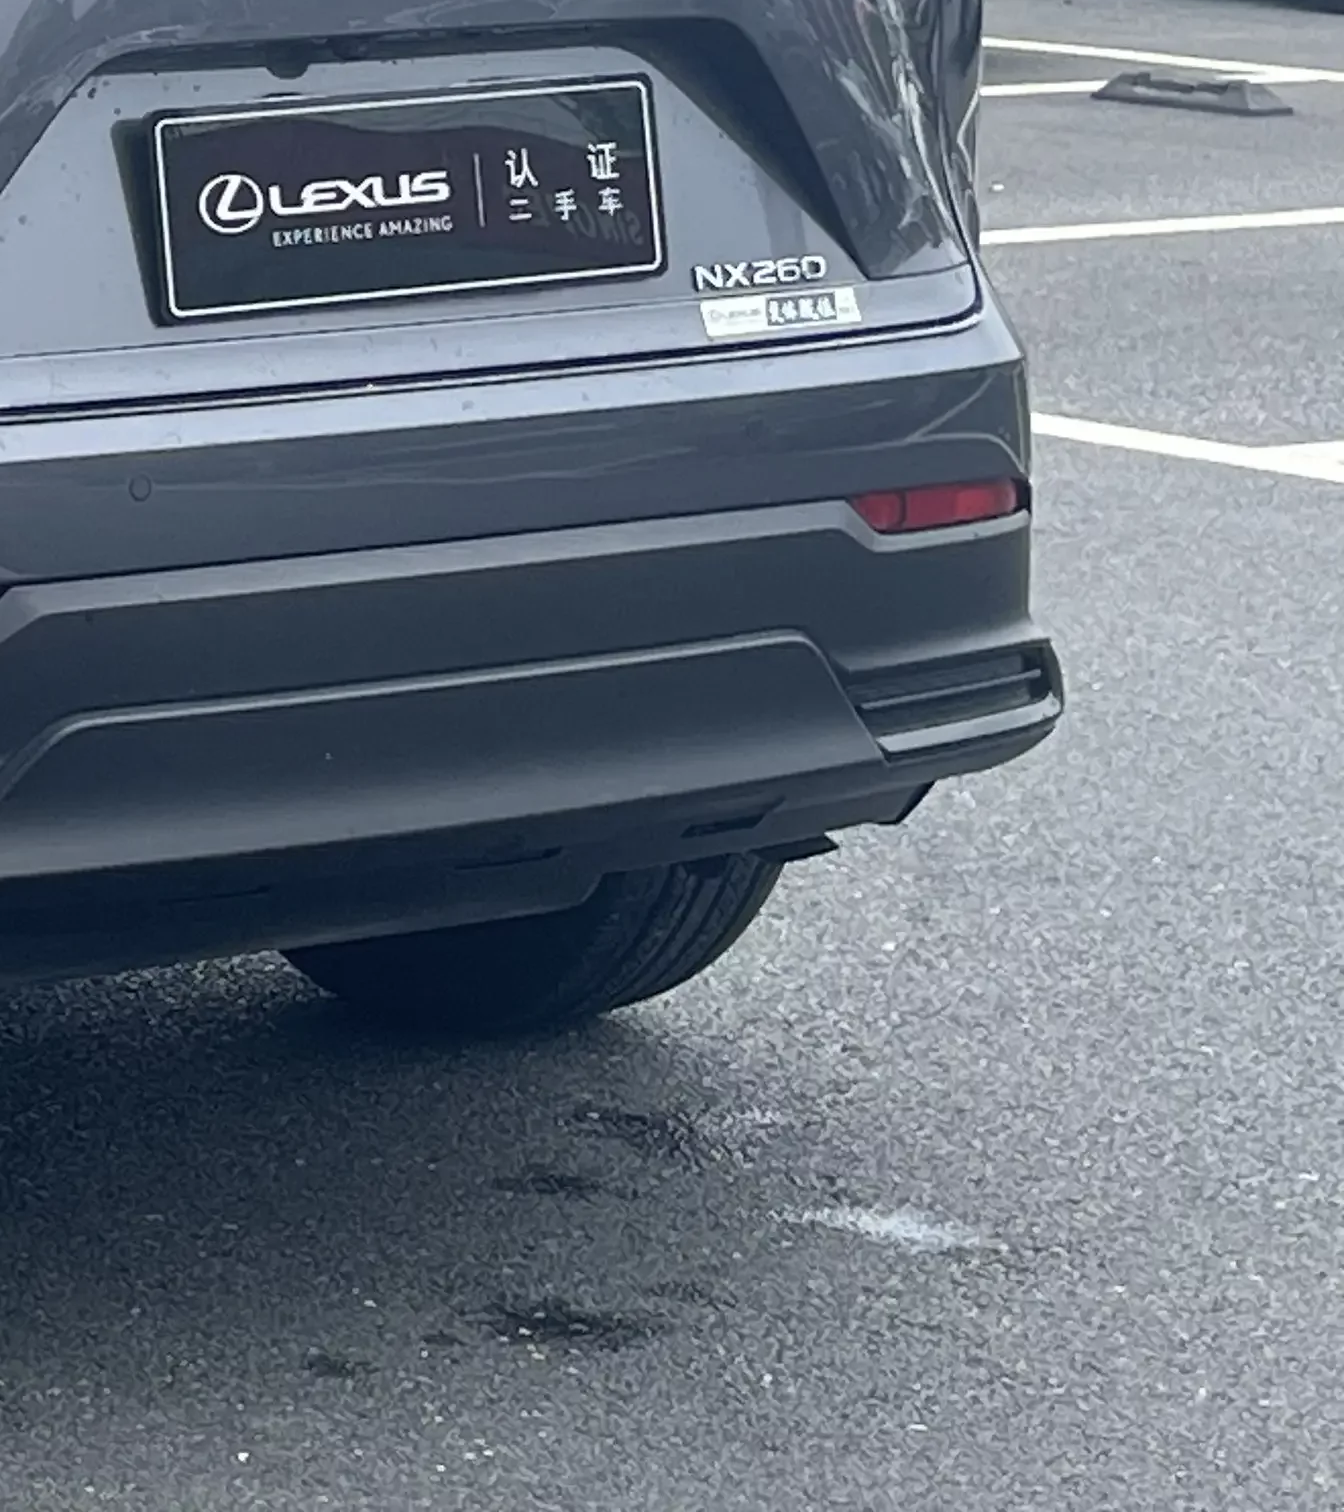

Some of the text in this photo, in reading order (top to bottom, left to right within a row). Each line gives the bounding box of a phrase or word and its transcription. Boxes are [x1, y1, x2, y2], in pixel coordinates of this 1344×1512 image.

[505, 142, 620, 188] 认证
[268, 171, 450, 215] LEXUS
[509, 187, 624, 221] 二手车
[272, 215, 454, 248] EXPERIENCE AMAZING
[694, 255, 827, 291] NX260
